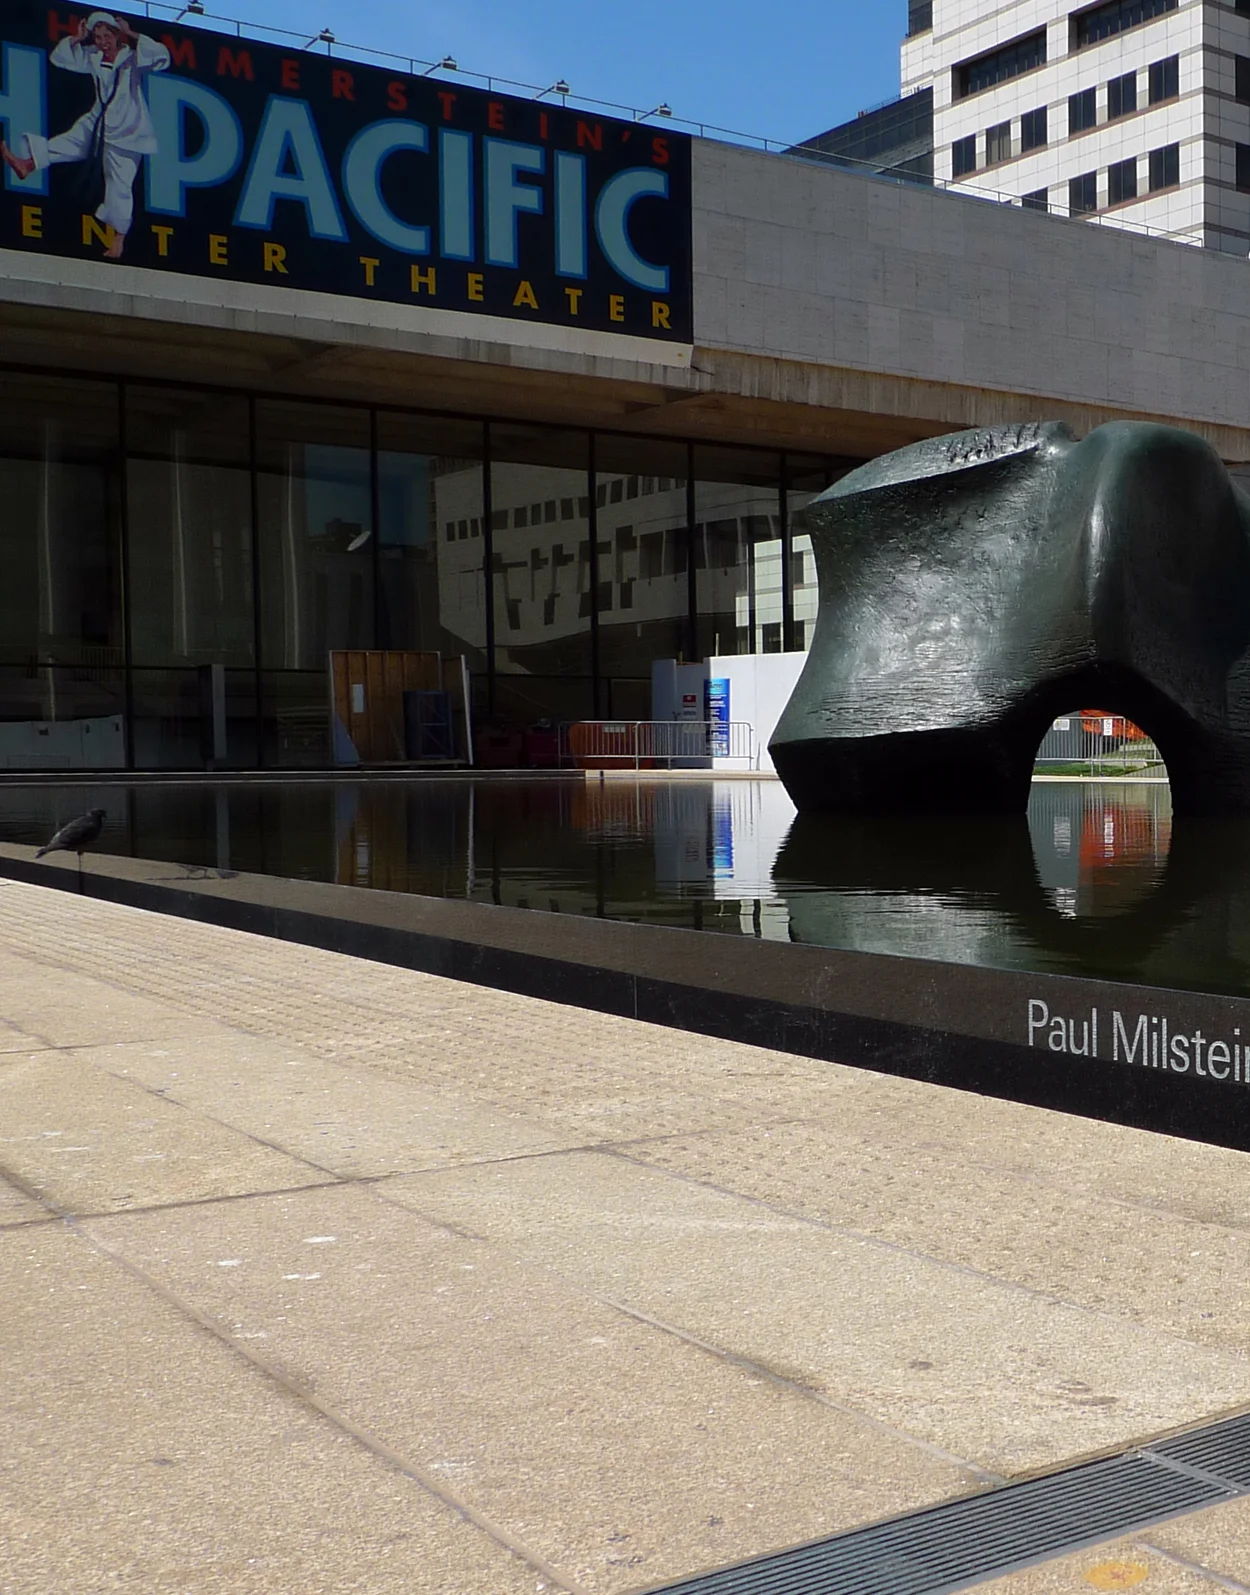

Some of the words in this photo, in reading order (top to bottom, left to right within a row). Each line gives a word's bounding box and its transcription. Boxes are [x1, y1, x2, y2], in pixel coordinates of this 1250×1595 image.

[48, 10, 669, 164] HMMERSTEIN'S
[143, 70, 671, 293] PACIFIC
[360, 257, 671, 330] THEATER
[1029, 998, 1098, 1058] Paul
